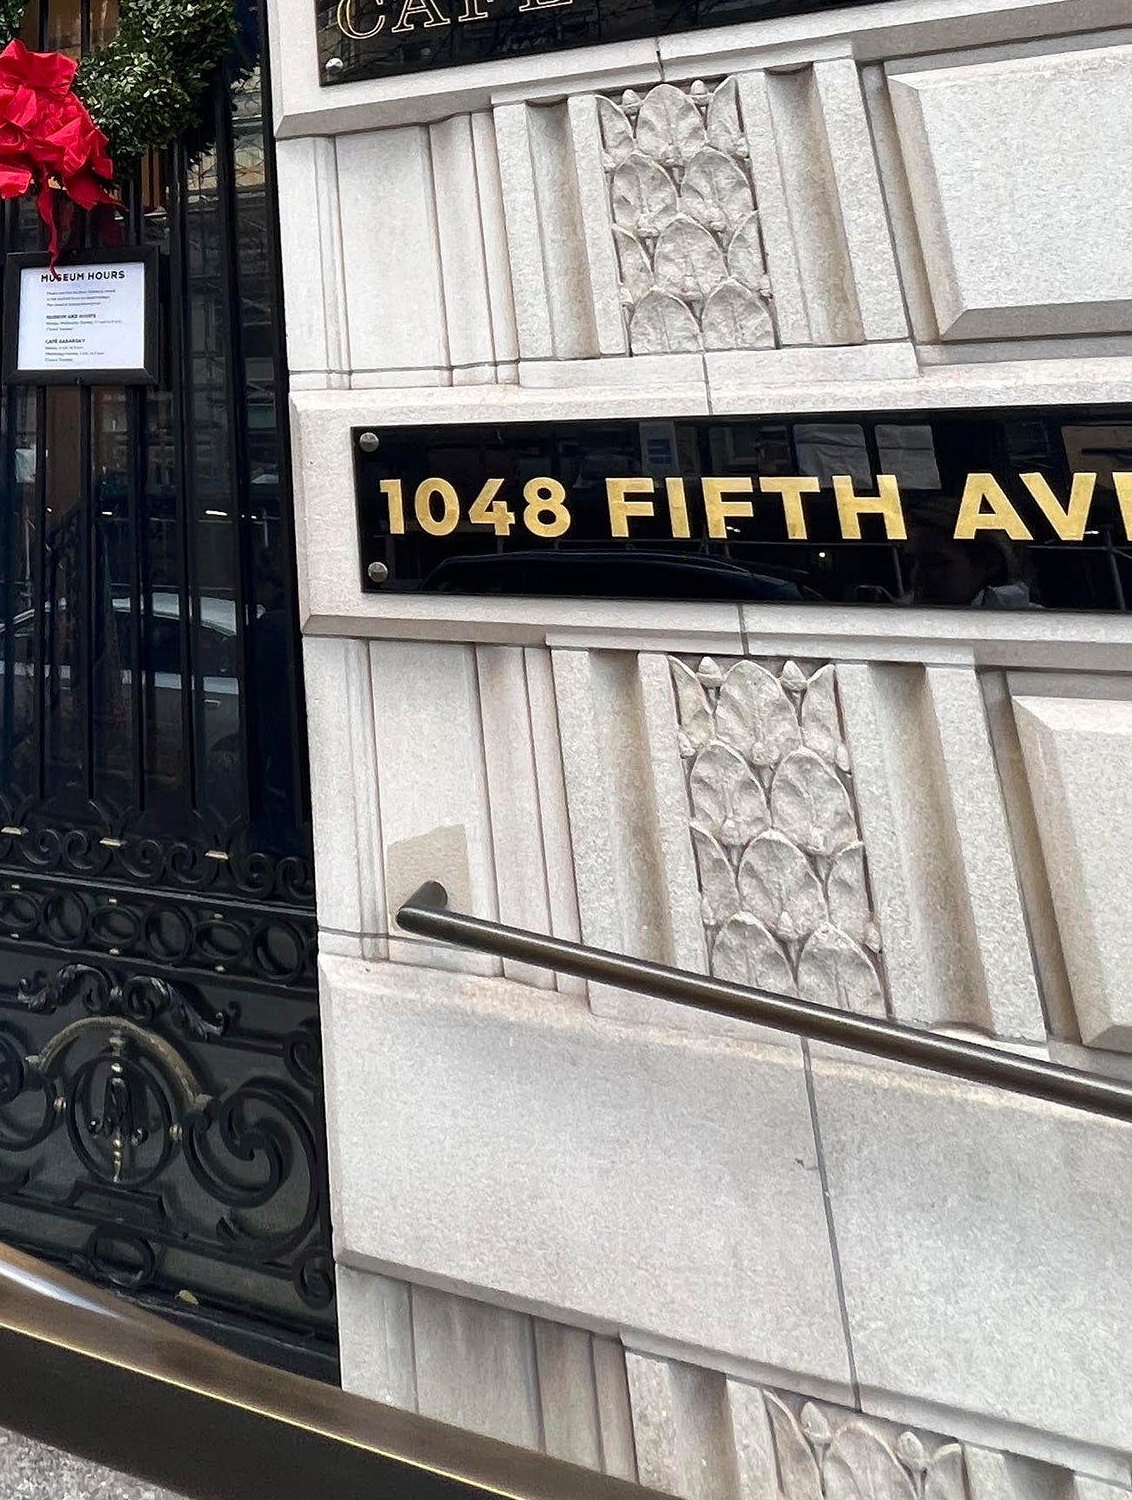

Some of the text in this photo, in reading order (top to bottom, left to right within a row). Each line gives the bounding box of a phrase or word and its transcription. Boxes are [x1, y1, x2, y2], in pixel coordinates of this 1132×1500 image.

[87, 270, 125, 281] HOURS
[379, 476, 571, 537] 1048
[604, 474, 908, 540] FIFTH
